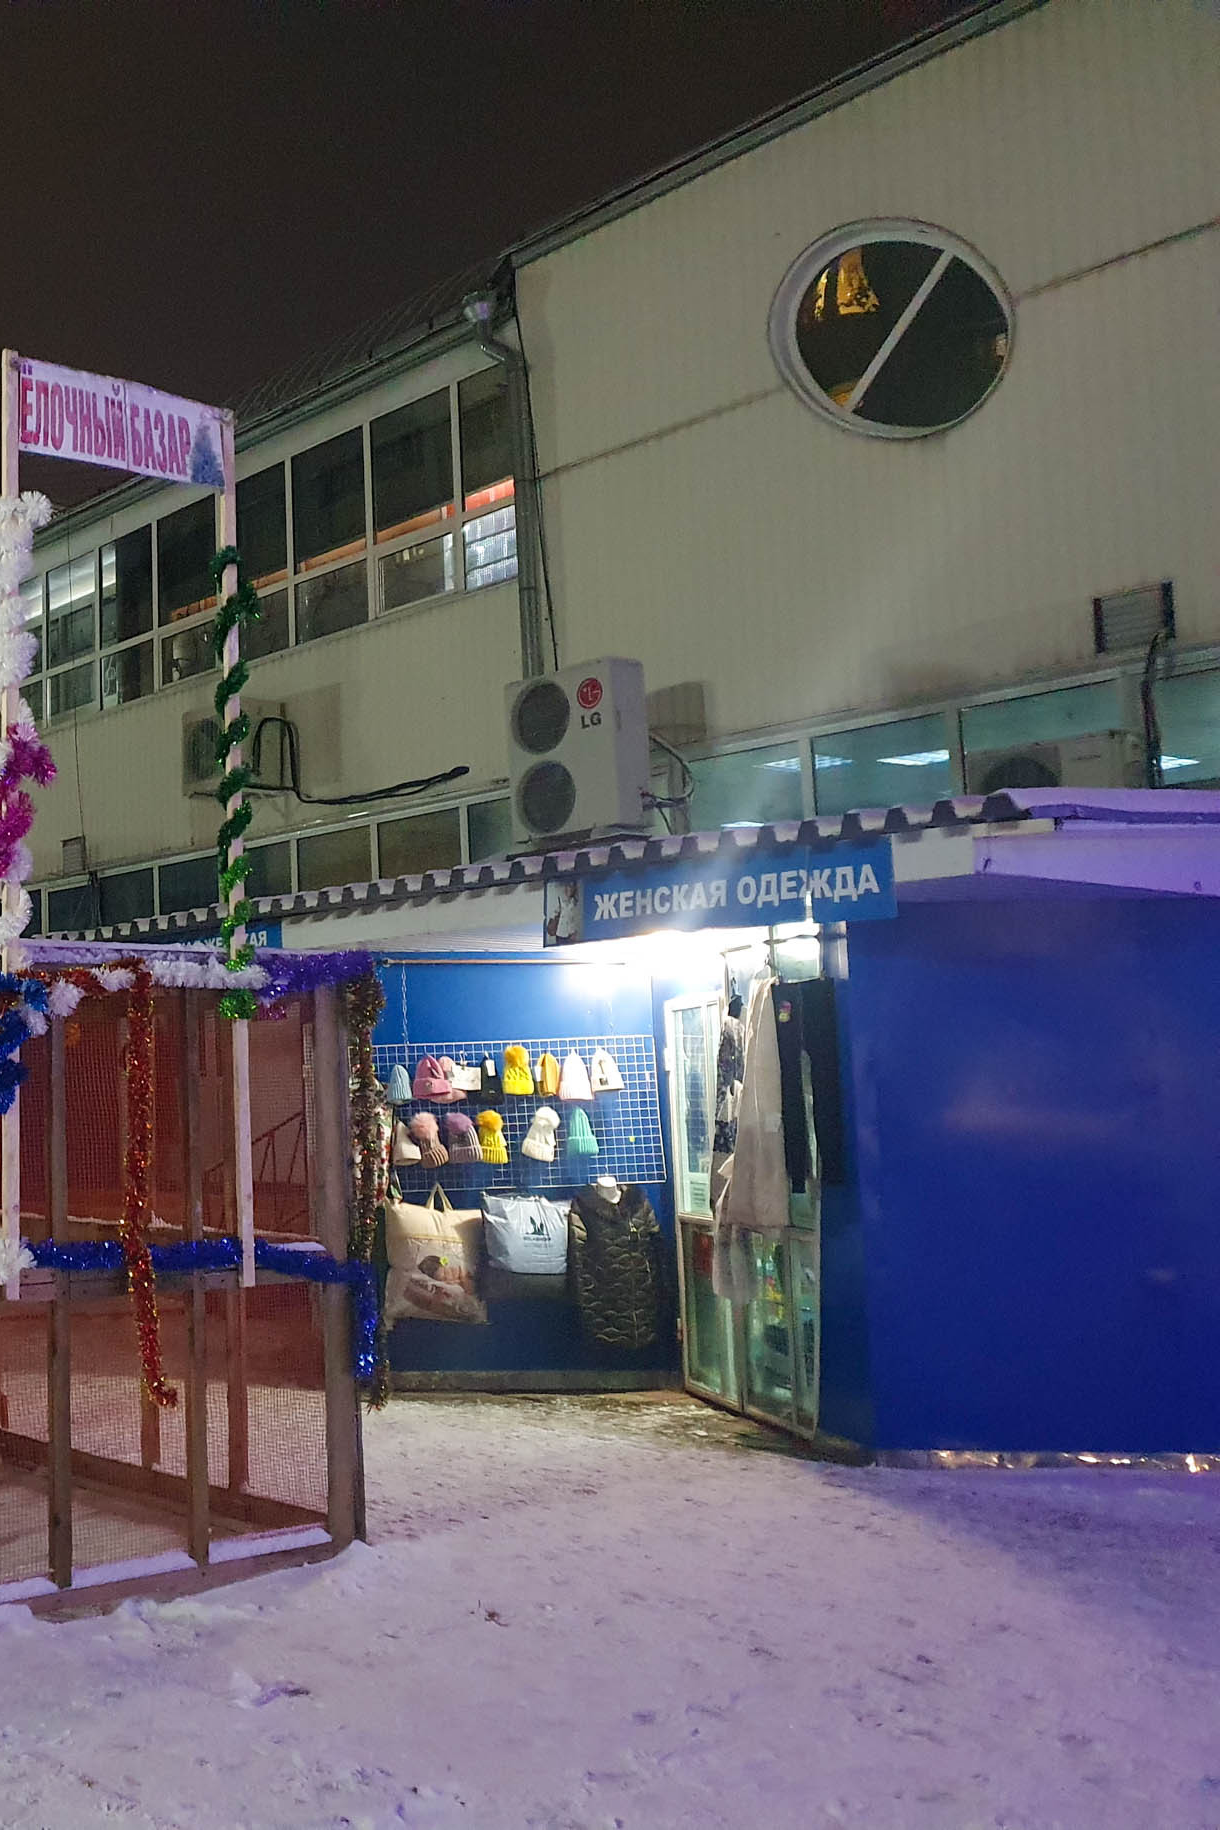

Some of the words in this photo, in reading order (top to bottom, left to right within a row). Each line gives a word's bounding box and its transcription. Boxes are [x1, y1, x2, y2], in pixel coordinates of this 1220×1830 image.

[19, 363, 127, 462] ЁЛОЧНЫЙ
[130, 402, 192, 477] БАЗАР
[580, 712, 602, 729] LG
[593, 879, 729, 921] ЖЕНСКАЯ
[737, 863, 880, 904] ОДЕЖДА
